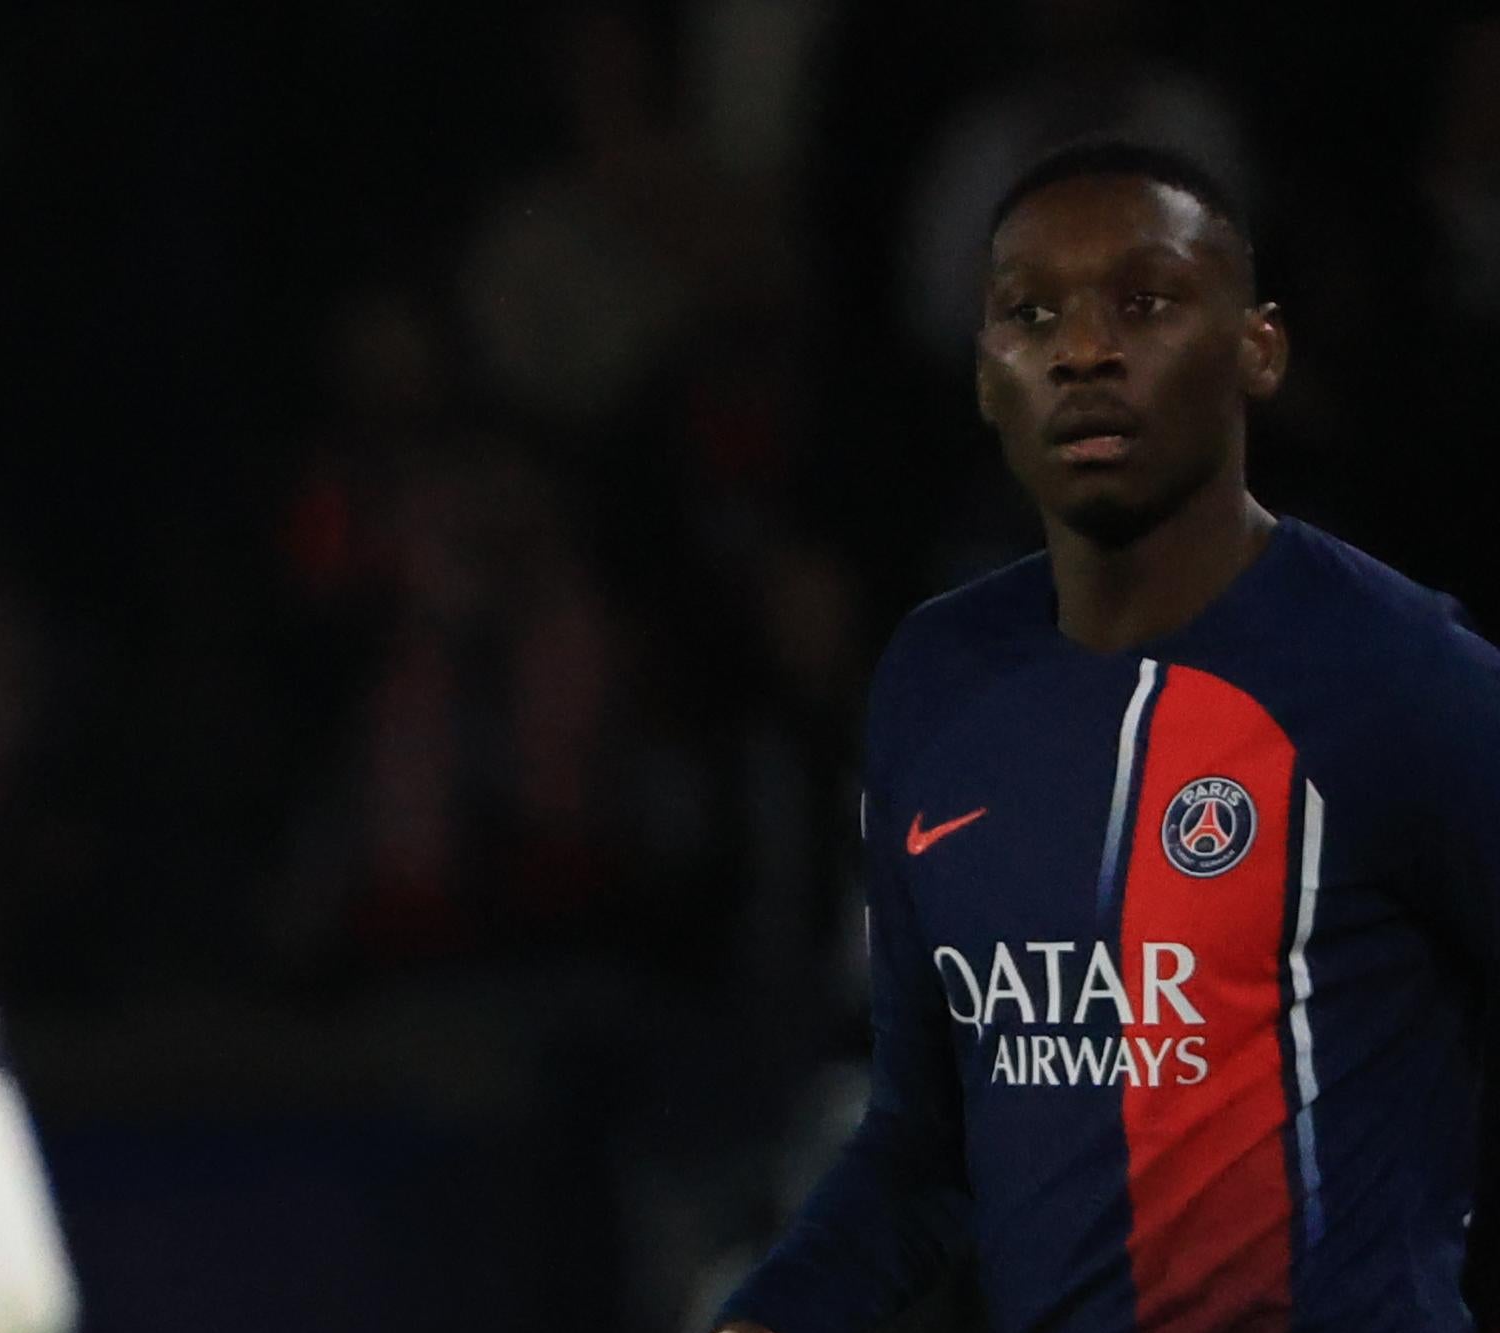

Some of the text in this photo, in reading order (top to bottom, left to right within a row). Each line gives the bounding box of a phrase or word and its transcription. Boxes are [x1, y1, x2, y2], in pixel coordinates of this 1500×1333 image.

[1182, 782, 1242, 807] PARIS
[933, 941, 1206, 1041] QATAR
[991, 1035, 1208, 1087] AIRWAYS
